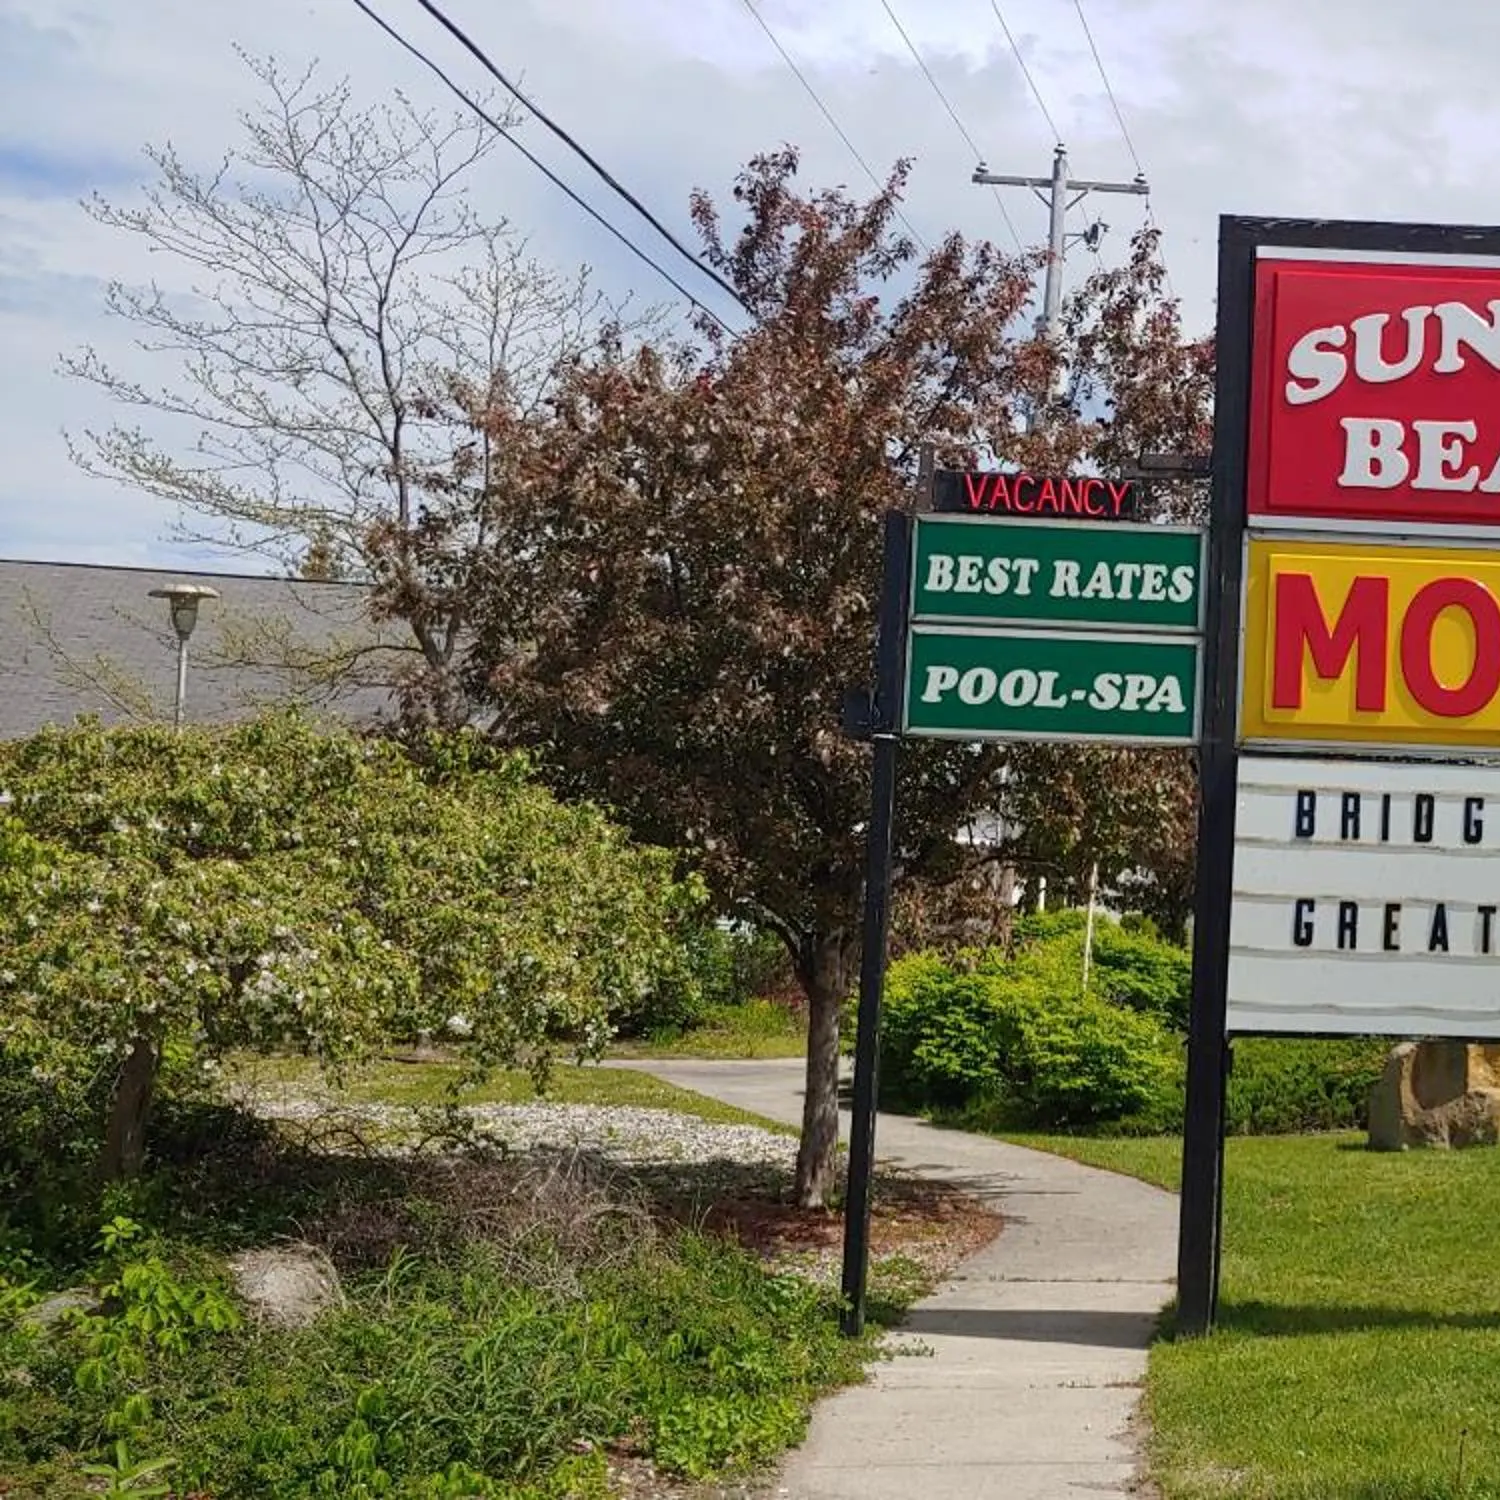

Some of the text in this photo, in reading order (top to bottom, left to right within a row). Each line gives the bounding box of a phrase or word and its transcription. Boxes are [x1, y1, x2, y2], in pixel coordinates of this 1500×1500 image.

[965, 472, 1133, 515] VACANCY
[924, 554, 1196, 602] BEST RATES
[921, 665, 1187, 713] POOL-SPA
[1292, 898, 1497, 954] GREAT
